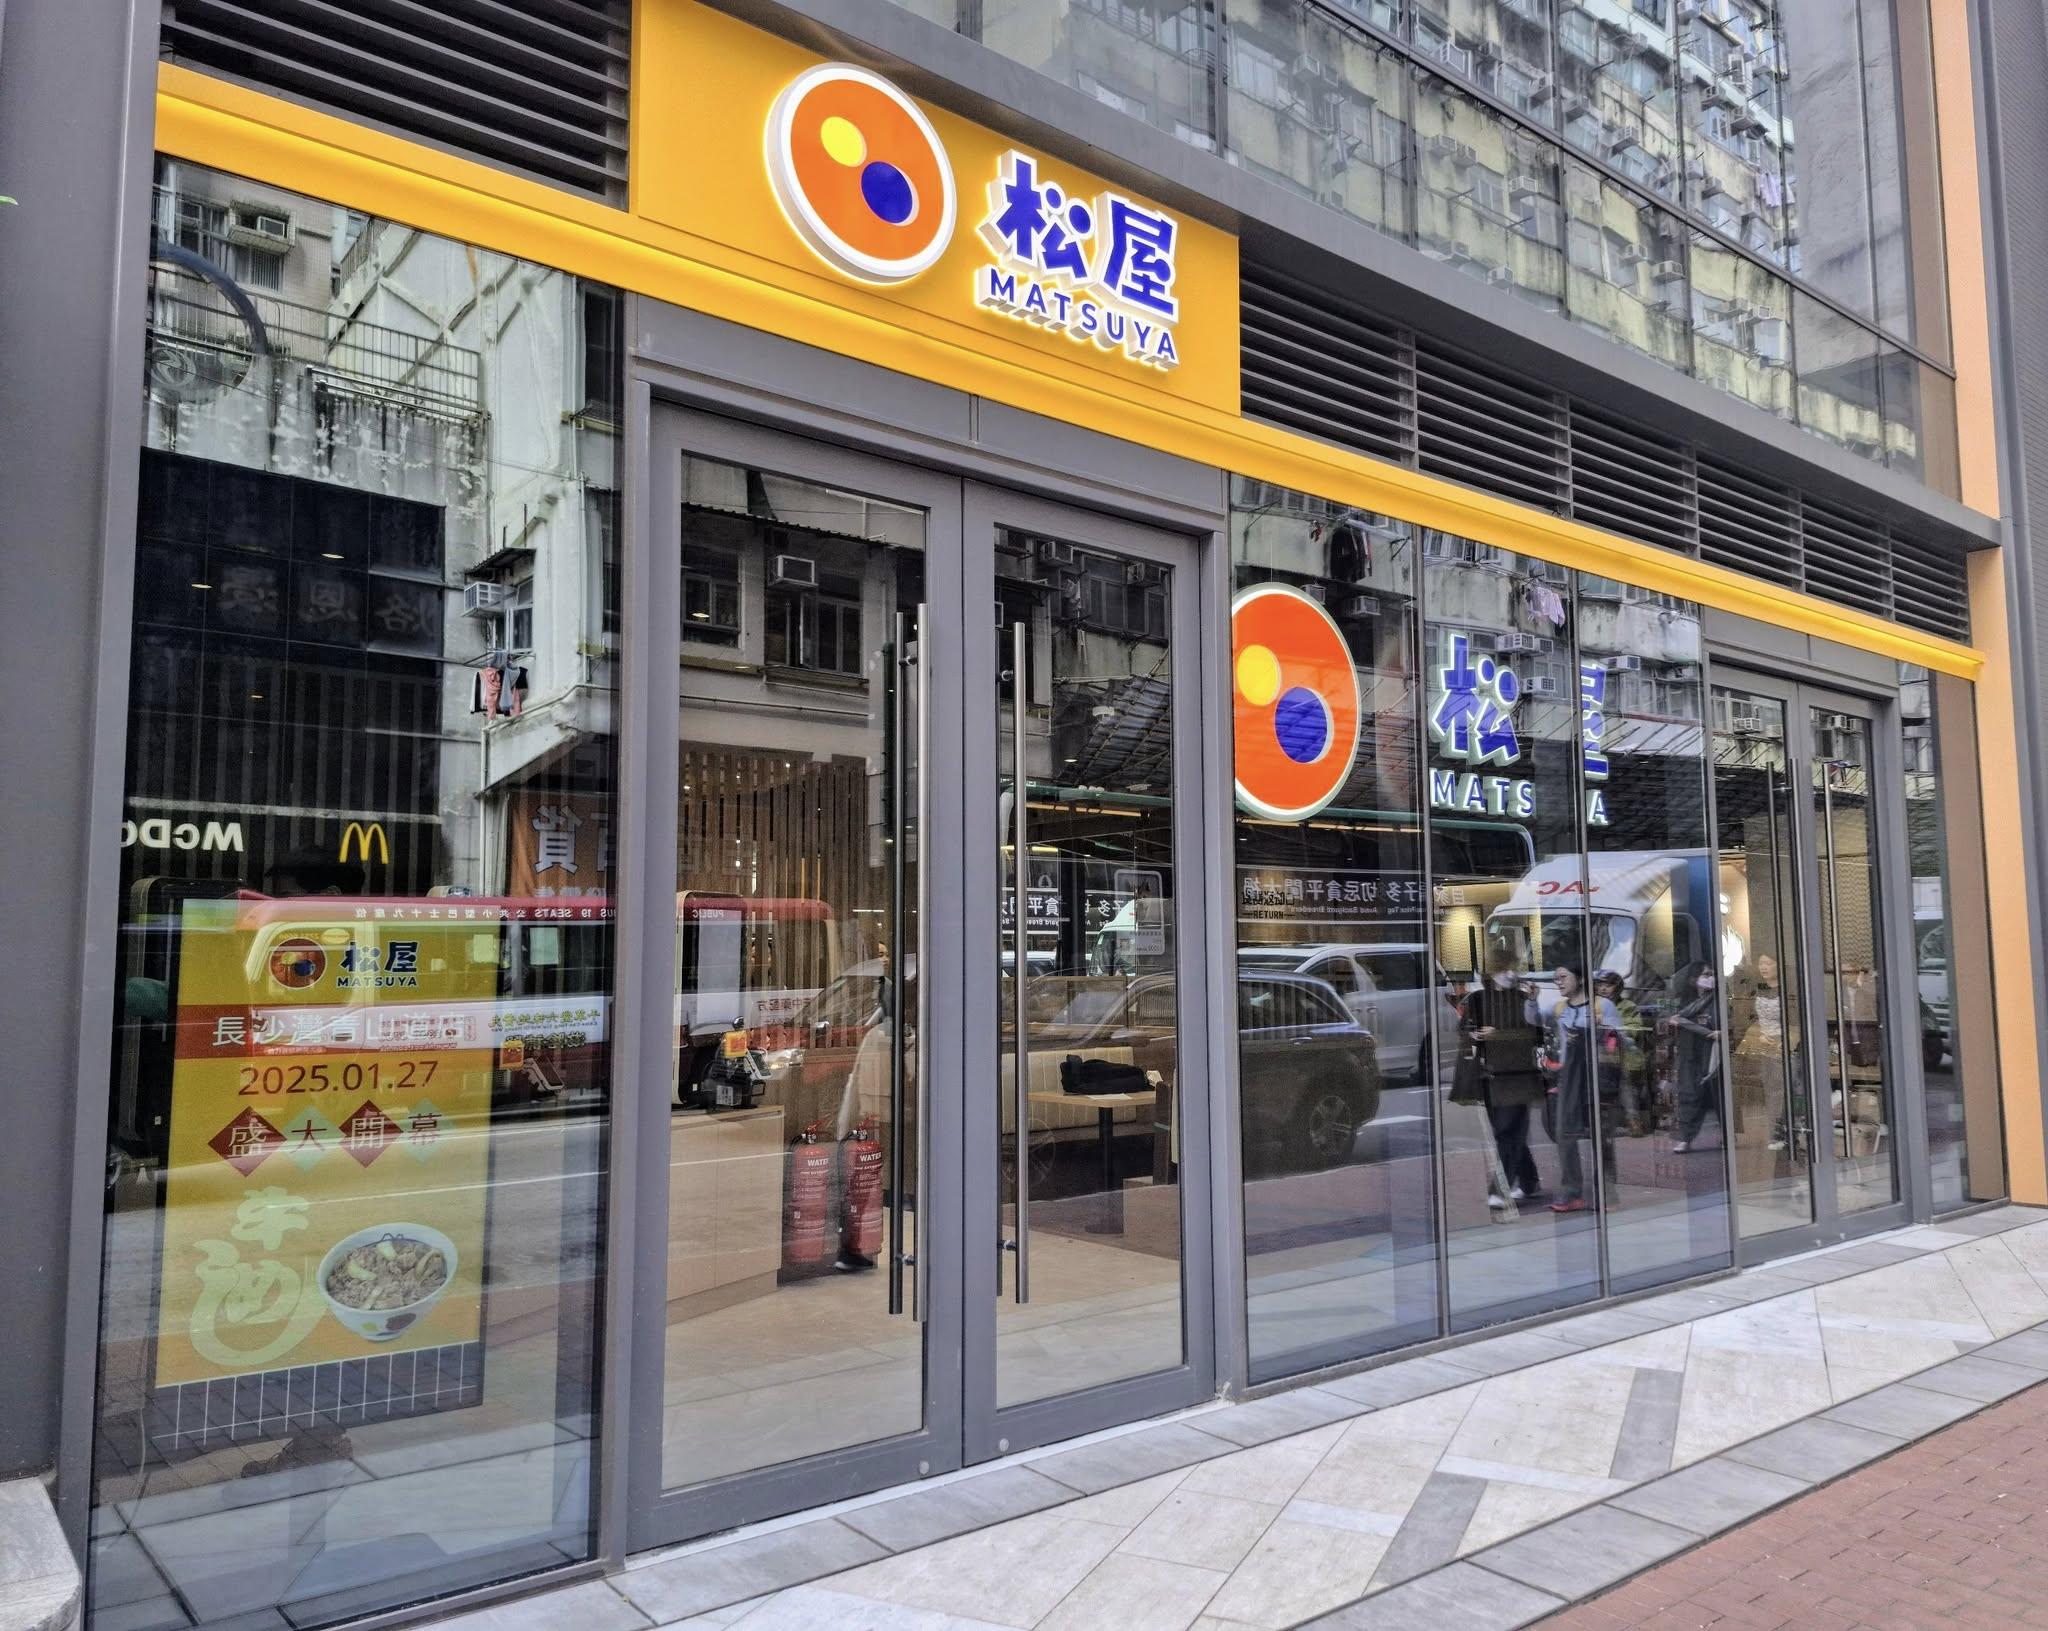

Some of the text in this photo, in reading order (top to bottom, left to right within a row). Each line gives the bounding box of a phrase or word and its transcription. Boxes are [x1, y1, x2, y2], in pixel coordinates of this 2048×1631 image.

[991, 152, 1179, 320] 松屋
[988, 266, 1178, 362] MATSUYA
[340, 942, 418, 973] 松屋
[337, 975, 418, 988] MATSUYA
[238, 1060, 439, 1096] 2025.01.27
[807, 1158, 829, 1168] WATE
